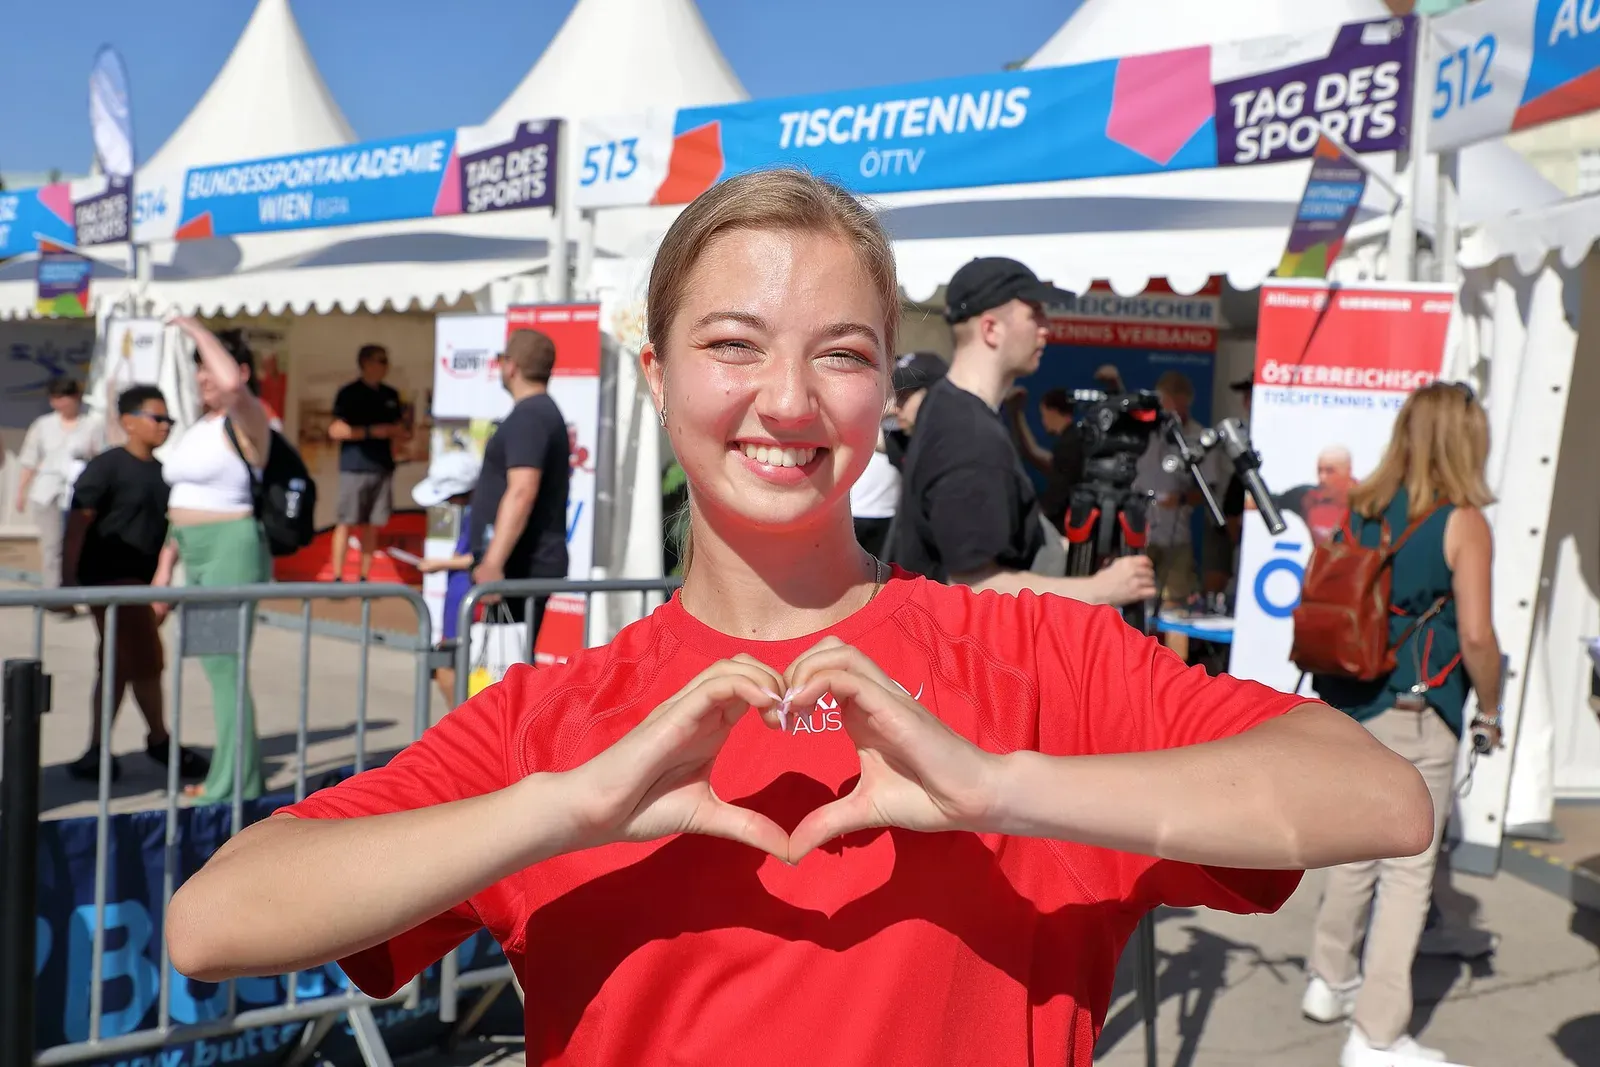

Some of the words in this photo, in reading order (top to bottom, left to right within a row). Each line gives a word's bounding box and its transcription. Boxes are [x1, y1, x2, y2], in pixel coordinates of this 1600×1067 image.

[1230, 81, 1307, 129] TAG
[1314, 61, 1401, 113] DES
[1432, 33, 1497, 120] 512
[778, 86, 1032, 149] TISCHTENNIS
[1234, 101, 1397, 164] SPORTS
[187, 139, 447, 200] BUNDESSPORTAKADEMIE
[465, 156, 505, 189] TAG
[505, 143, 549, 179] DES
[579, 138, 639, 187] 513
[859, 146, 926, 178] ÖTTV
[258, 191, 314, 224] WIEN
[466, 171, 547, 213] SPORTS
[1114, 325, 1213, 348] VERBAND
